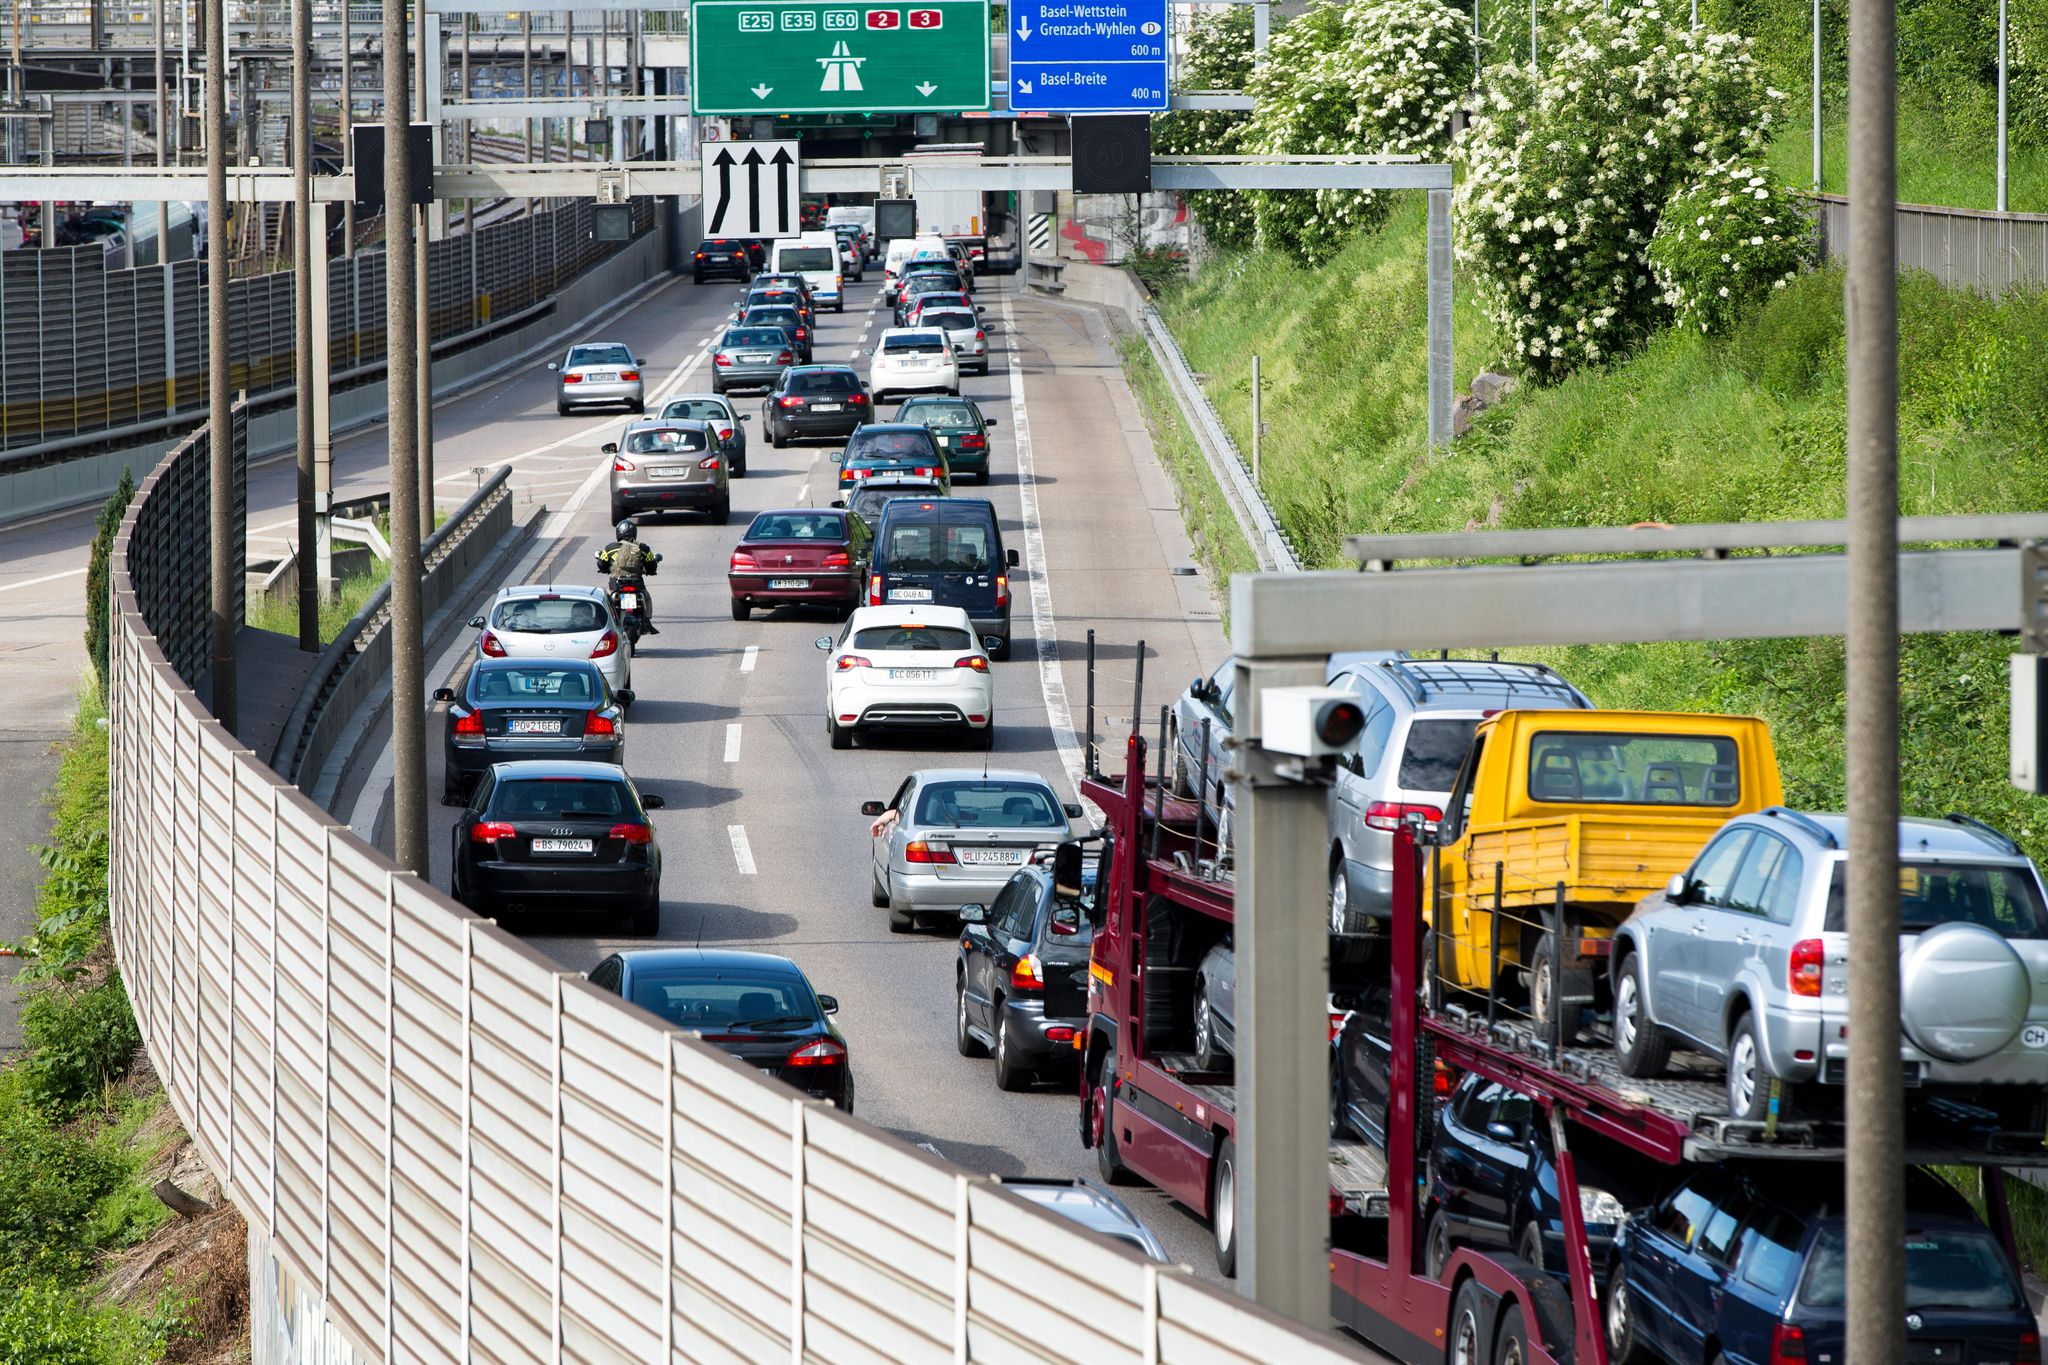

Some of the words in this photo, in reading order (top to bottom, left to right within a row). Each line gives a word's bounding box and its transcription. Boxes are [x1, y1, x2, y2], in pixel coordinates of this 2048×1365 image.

[1040, 5, 1127, 18] Basel-Wettstein
[742, 14, 771, 28] E25
[784, 14, 813, 27] E35
[826, 14, 855, 27] E60
[878, 14, 888, 26] 2
[921, 13, 930, 26] 3
[1040, 22, 1136, 39] Grenzach-Wyhlen
[1131, 45, 1149, 56] 600
[1152, 47, 1161, 56] m
[1040, 72, 1107, 86] Basel-Breite
[1131, 88, 1149, 99] 400
[1152, 90, 1161, 99] m
[2025, 1030, 2045, 1043] CH
